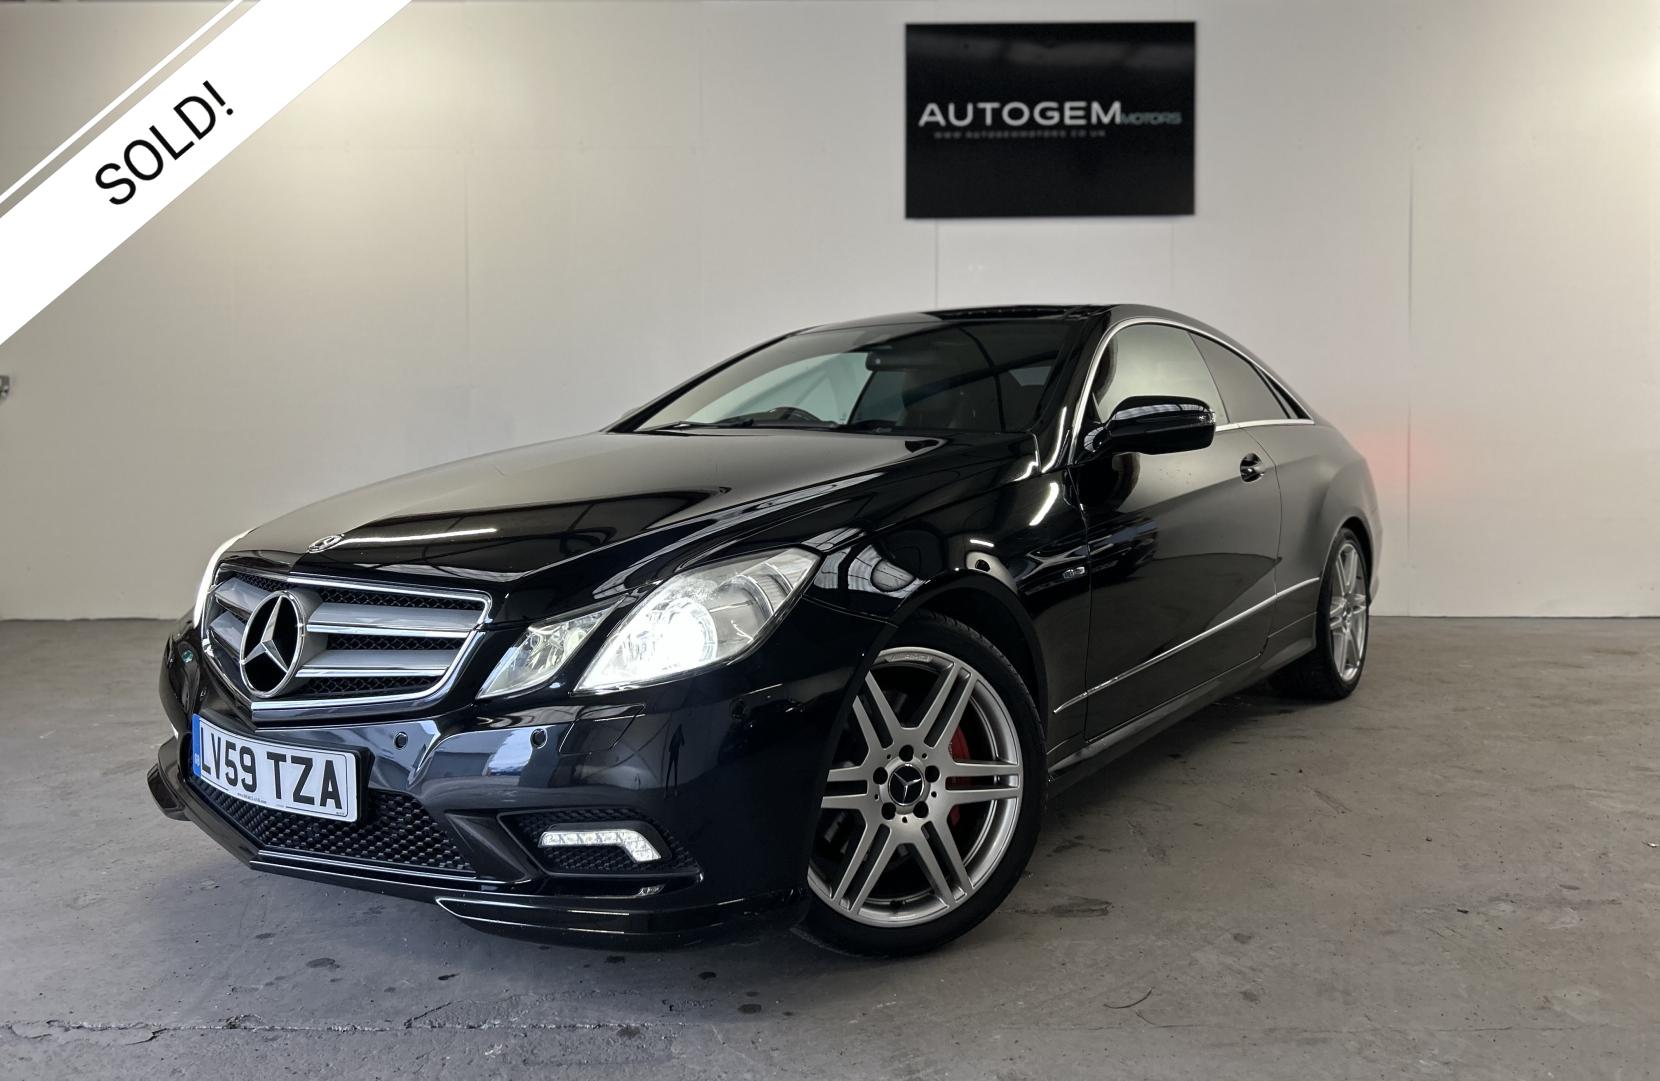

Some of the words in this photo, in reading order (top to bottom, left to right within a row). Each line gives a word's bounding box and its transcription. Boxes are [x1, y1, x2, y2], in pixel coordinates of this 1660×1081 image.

[918, 101, 1121, 127] AUTOGEM
[1121, 112, 1182, 125] MOTORS
[200, 727, 257, 793] LV59
[266, 751, 342, 809] TZA
